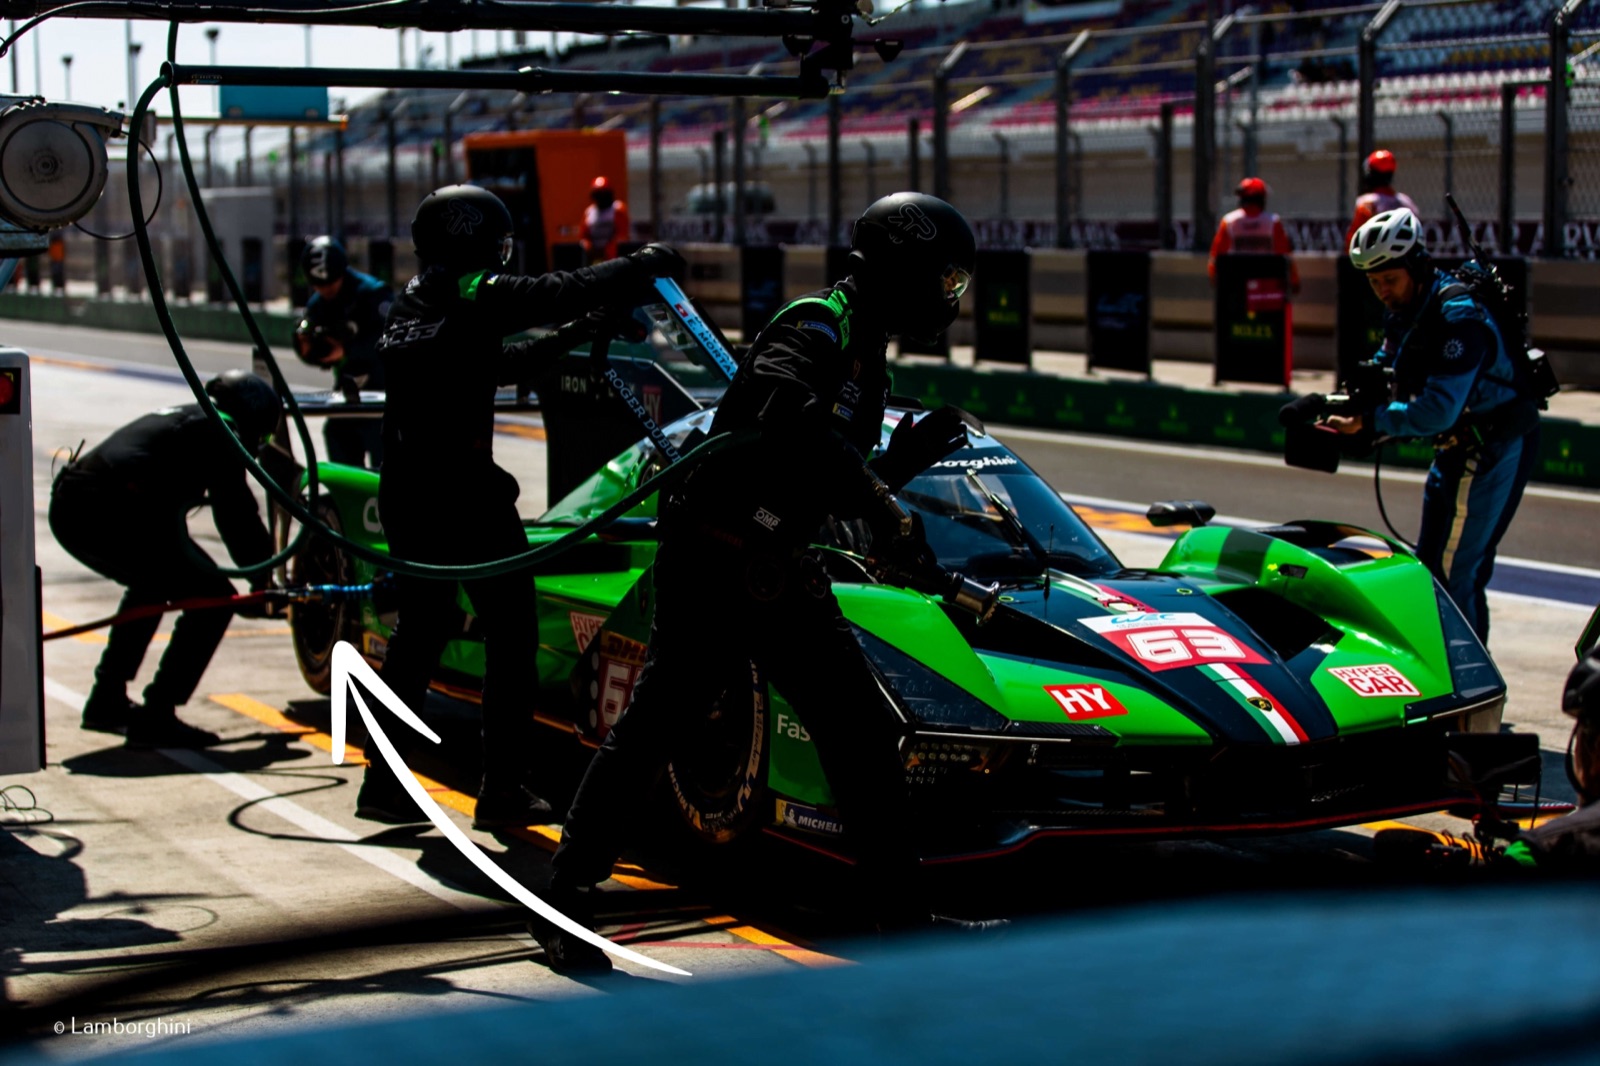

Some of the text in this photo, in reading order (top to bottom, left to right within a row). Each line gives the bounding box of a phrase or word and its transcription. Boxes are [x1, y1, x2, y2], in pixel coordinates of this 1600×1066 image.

[560, 375, 588, 394] IRON
[604, 368, 646, 418] ROGER
[755, 508, 780, 529] OMP
[1126, 629, 1246, 665] 63
[1334, 666, 1397, 680] HYPER
[1348, 675, 1414, 695] CAR
[602, 660, 644, 728] 6
[1050, 687, 1112, 714] HY
